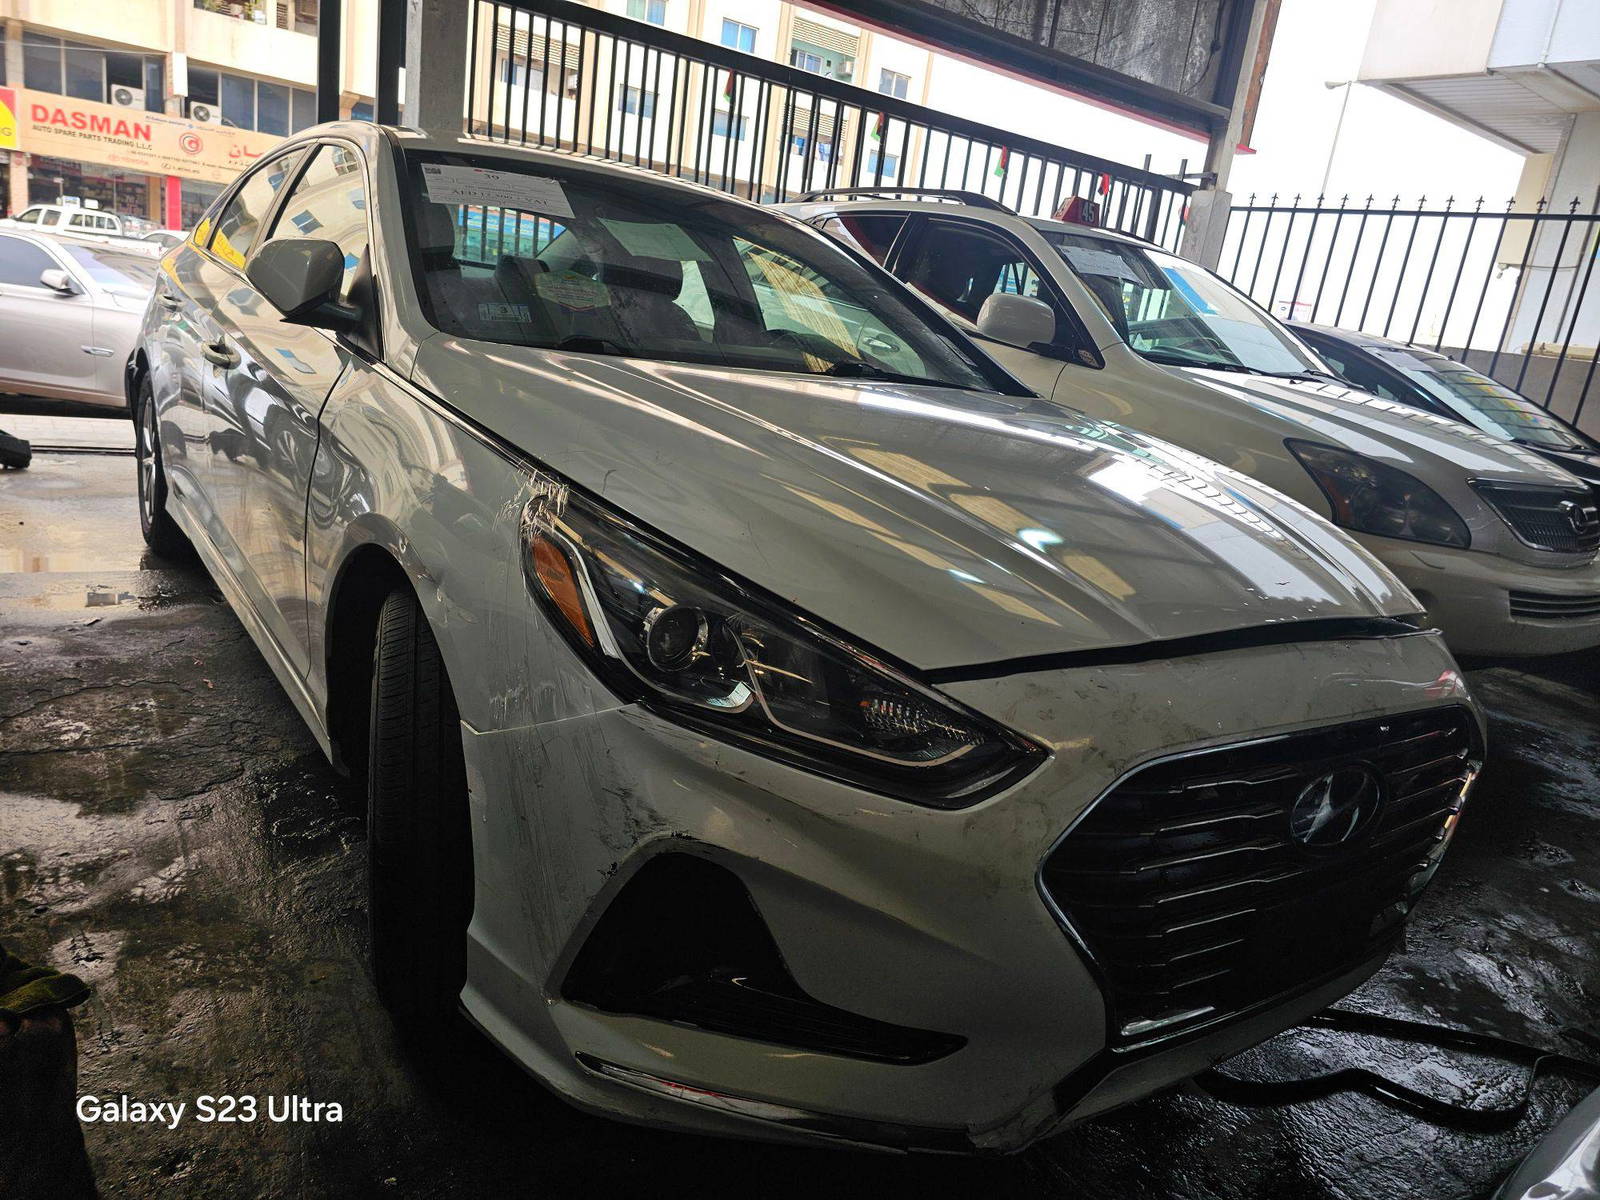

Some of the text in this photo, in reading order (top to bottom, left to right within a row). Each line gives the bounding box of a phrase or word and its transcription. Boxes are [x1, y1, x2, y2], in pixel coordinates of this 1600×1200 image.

[31, 104, 151, 142] DASMAN
[32, 125, 52, 135] AUTO
[54, 128, 77, 138] SPARE
[79, 131, 101, 142] PARTS
[103, 136, 135, 148] TRADING
[1082, 202, 1095, 222] 45
